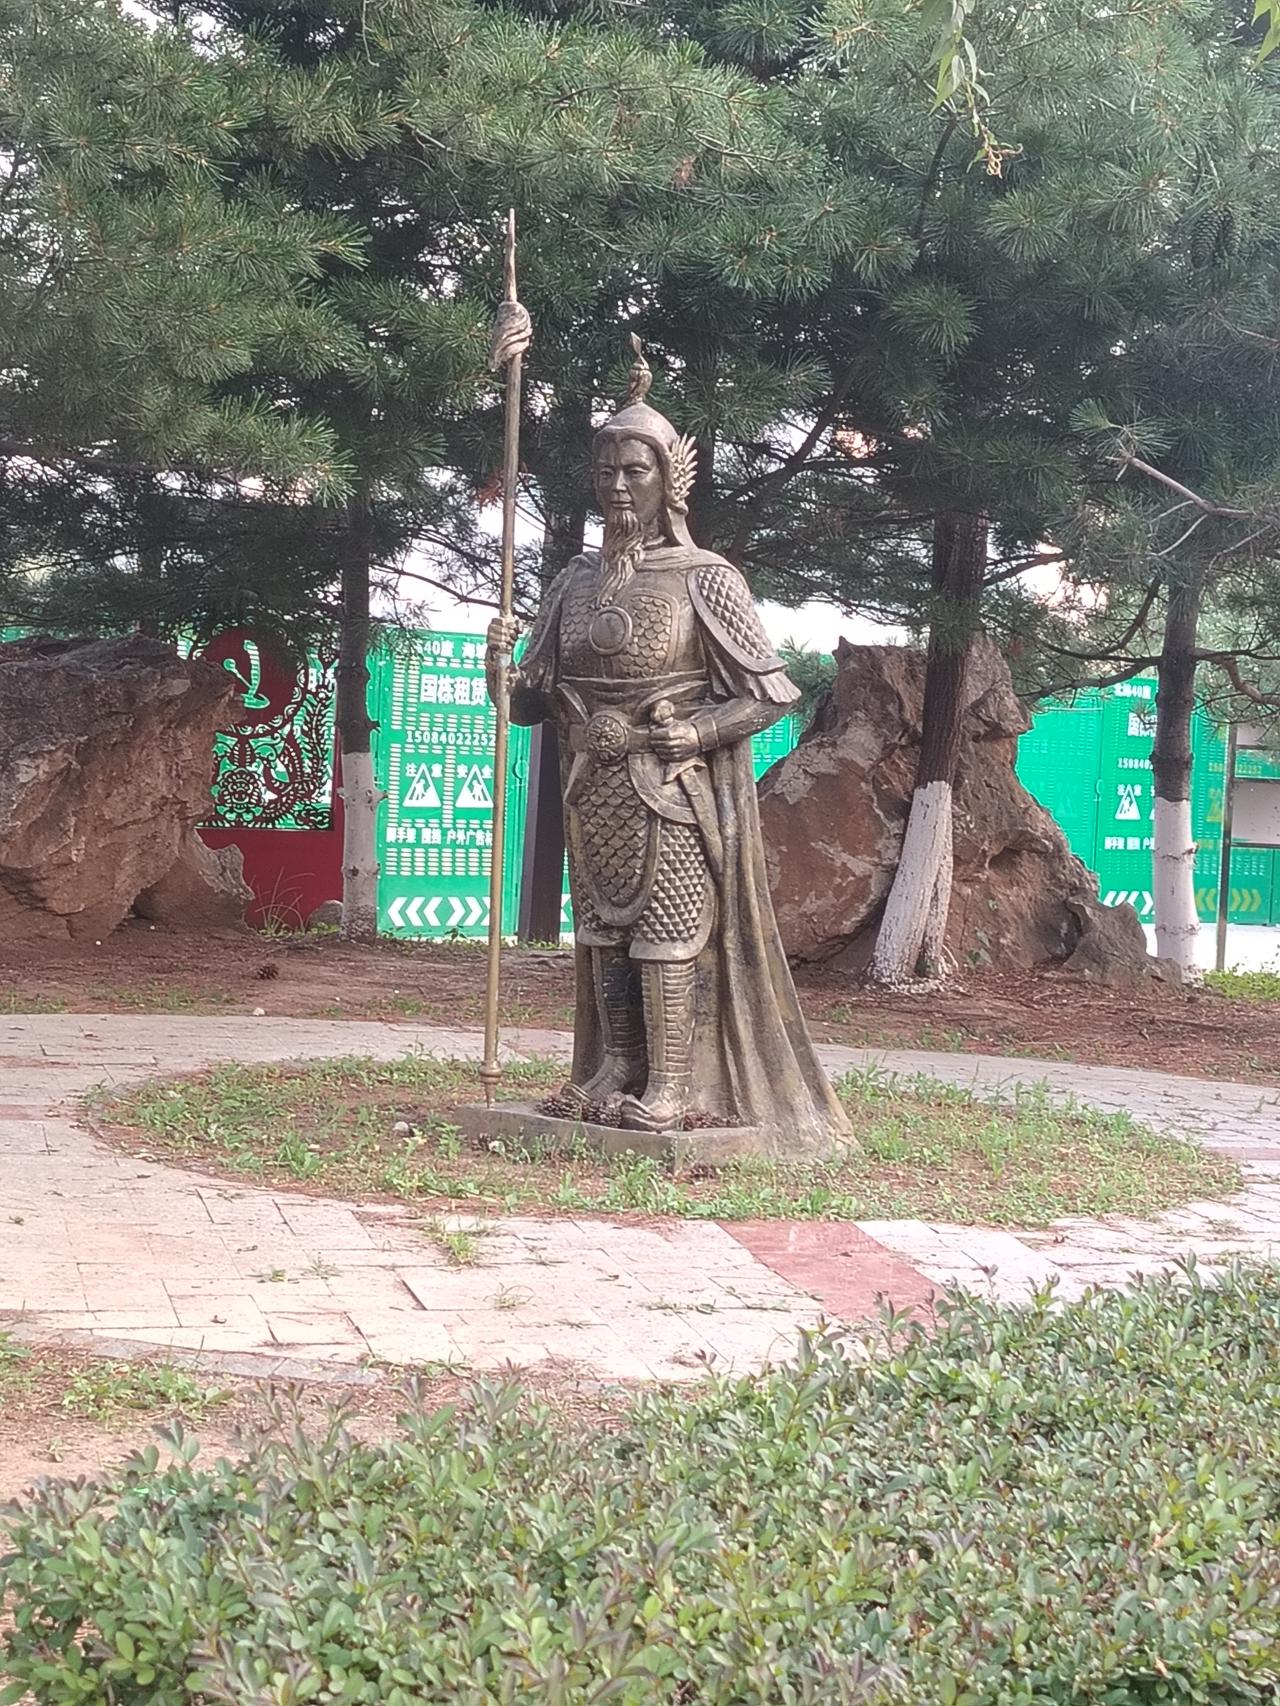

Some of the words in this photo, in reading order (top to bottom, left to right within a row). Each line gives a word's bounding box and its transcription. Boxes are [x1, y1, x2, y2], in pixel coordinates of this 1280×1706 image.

[419, 673, 488, 707] 国栋租赁
[406, 730, 497, 747] 15084022252
